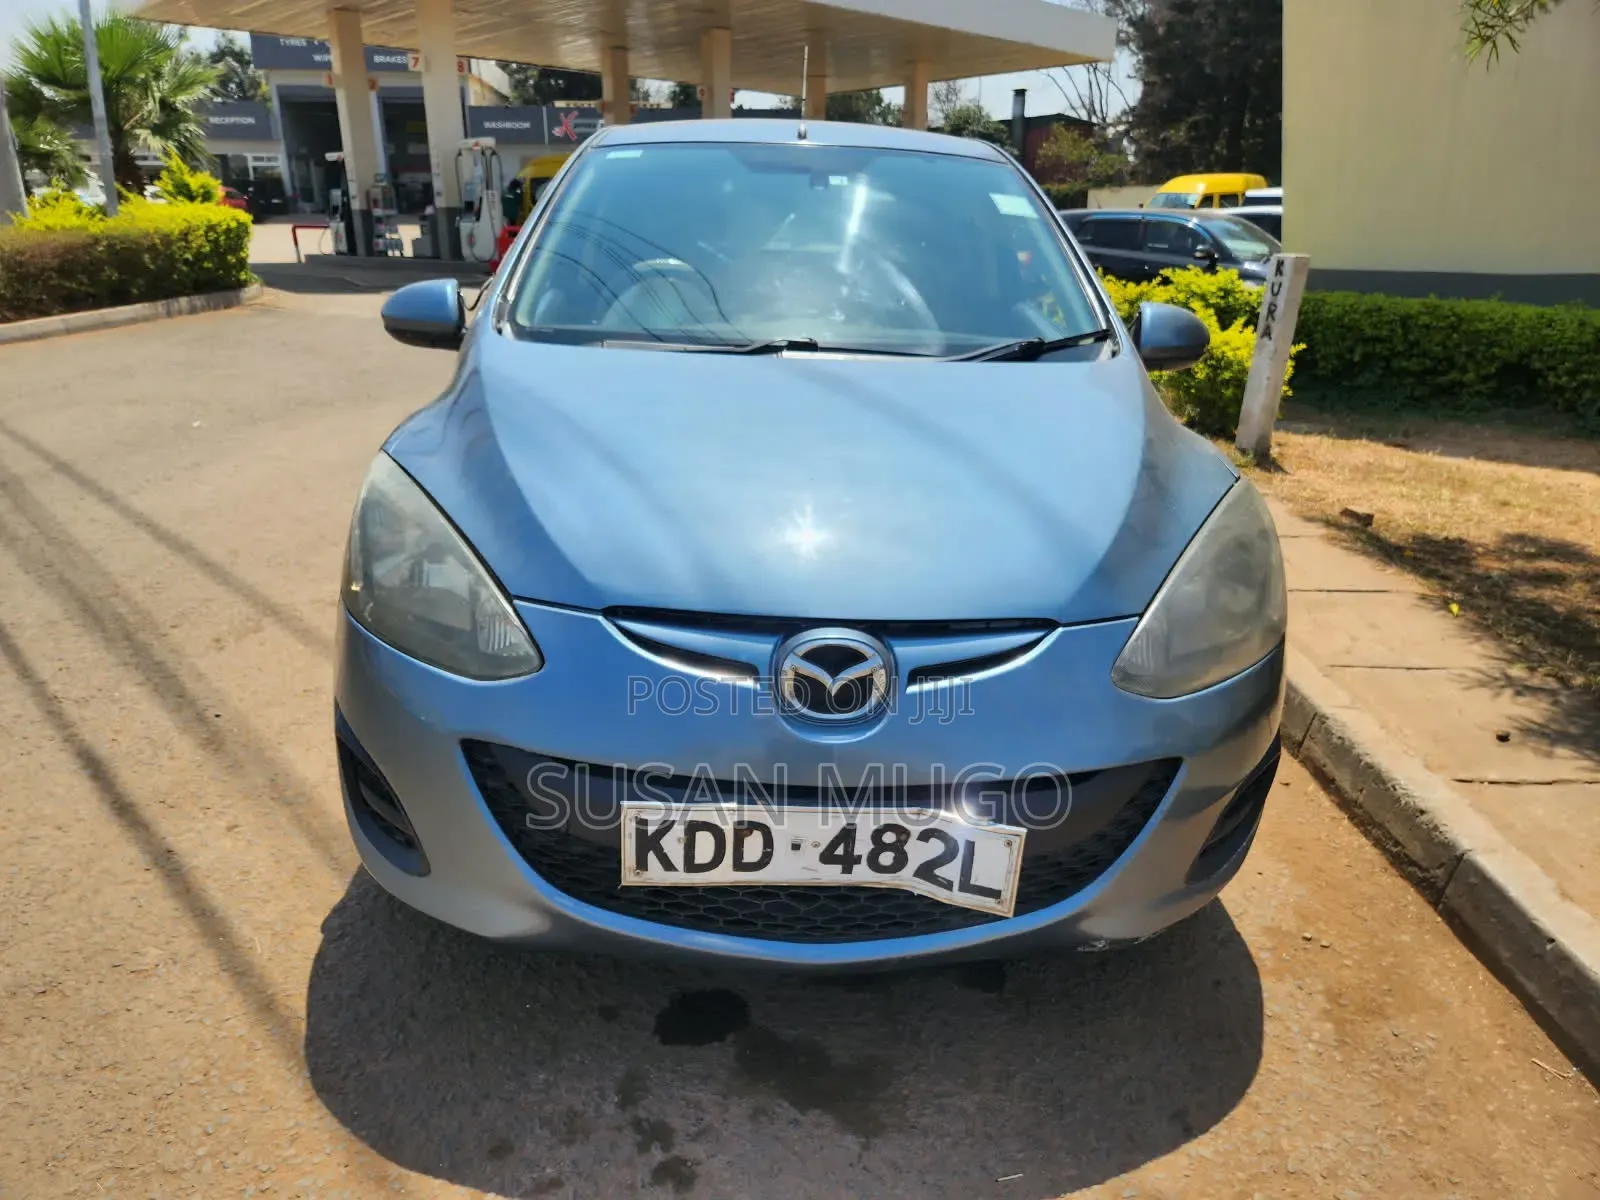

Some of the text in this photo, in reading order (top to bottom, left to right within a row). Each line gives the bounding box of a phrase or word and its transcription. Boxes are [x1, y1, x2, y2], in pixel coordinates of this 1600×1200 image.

[373, 55, 407, 64] BRAKES
[411, 56, 420, 68] 7
[208, 116, 256, 124] RECEPTION
[483, 121, 531, 129] WASHROOM
[1260, 259, 1285, 341] KURA
[634, 816, 1003, 899] KDD 482L
